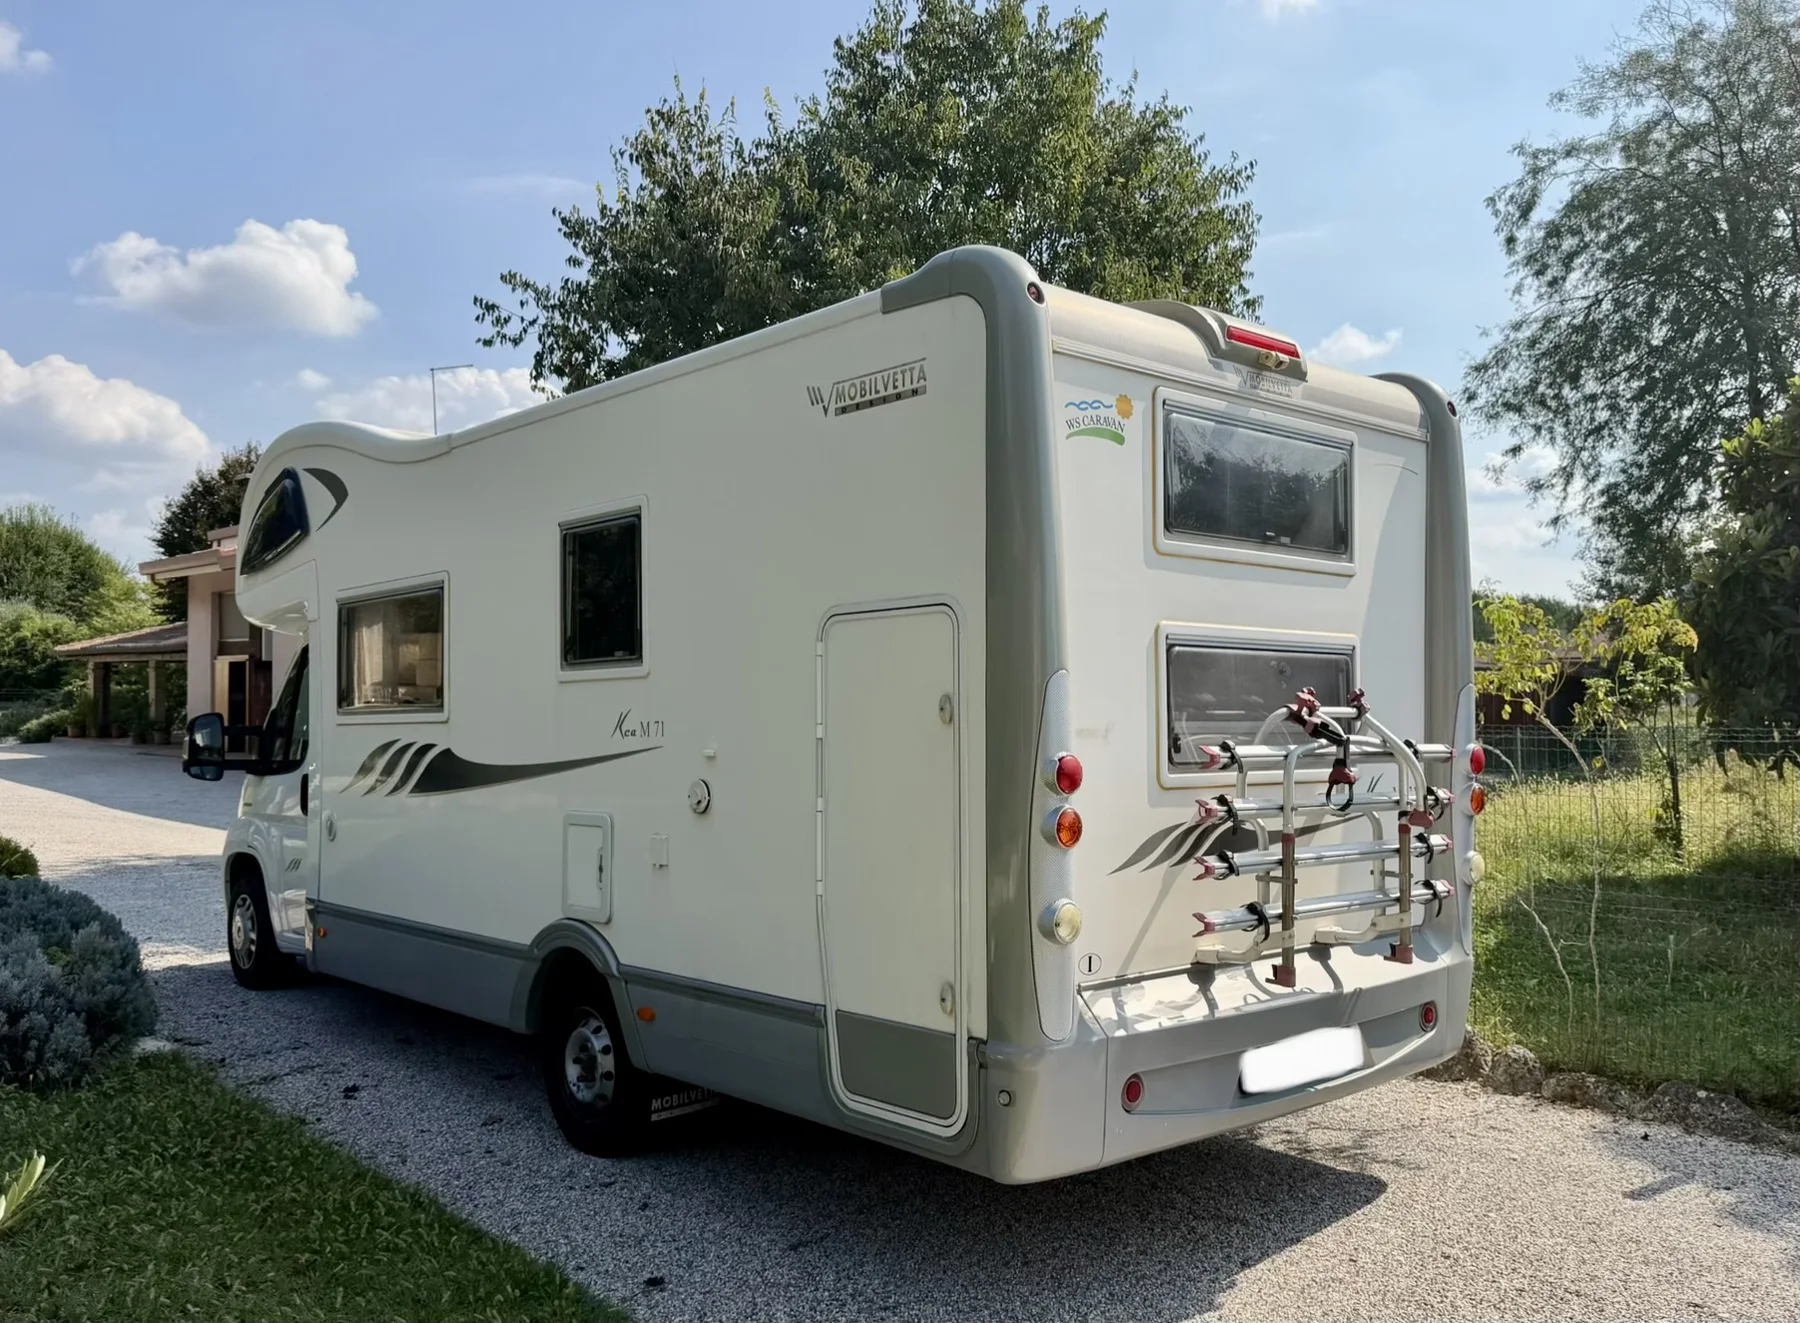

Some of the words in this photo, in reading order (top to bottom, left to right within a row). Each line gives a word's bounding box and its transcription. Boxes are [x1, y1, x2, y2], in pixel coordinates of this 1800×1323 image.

[834, 363, 927, 405] MOBILVETTA
[1065, 416, 1082, 431] WS
[1082, 414, 1126, 433] CARAVAN
[640, 720, 650, 738] M
[654, 720, 665, 738] 71
